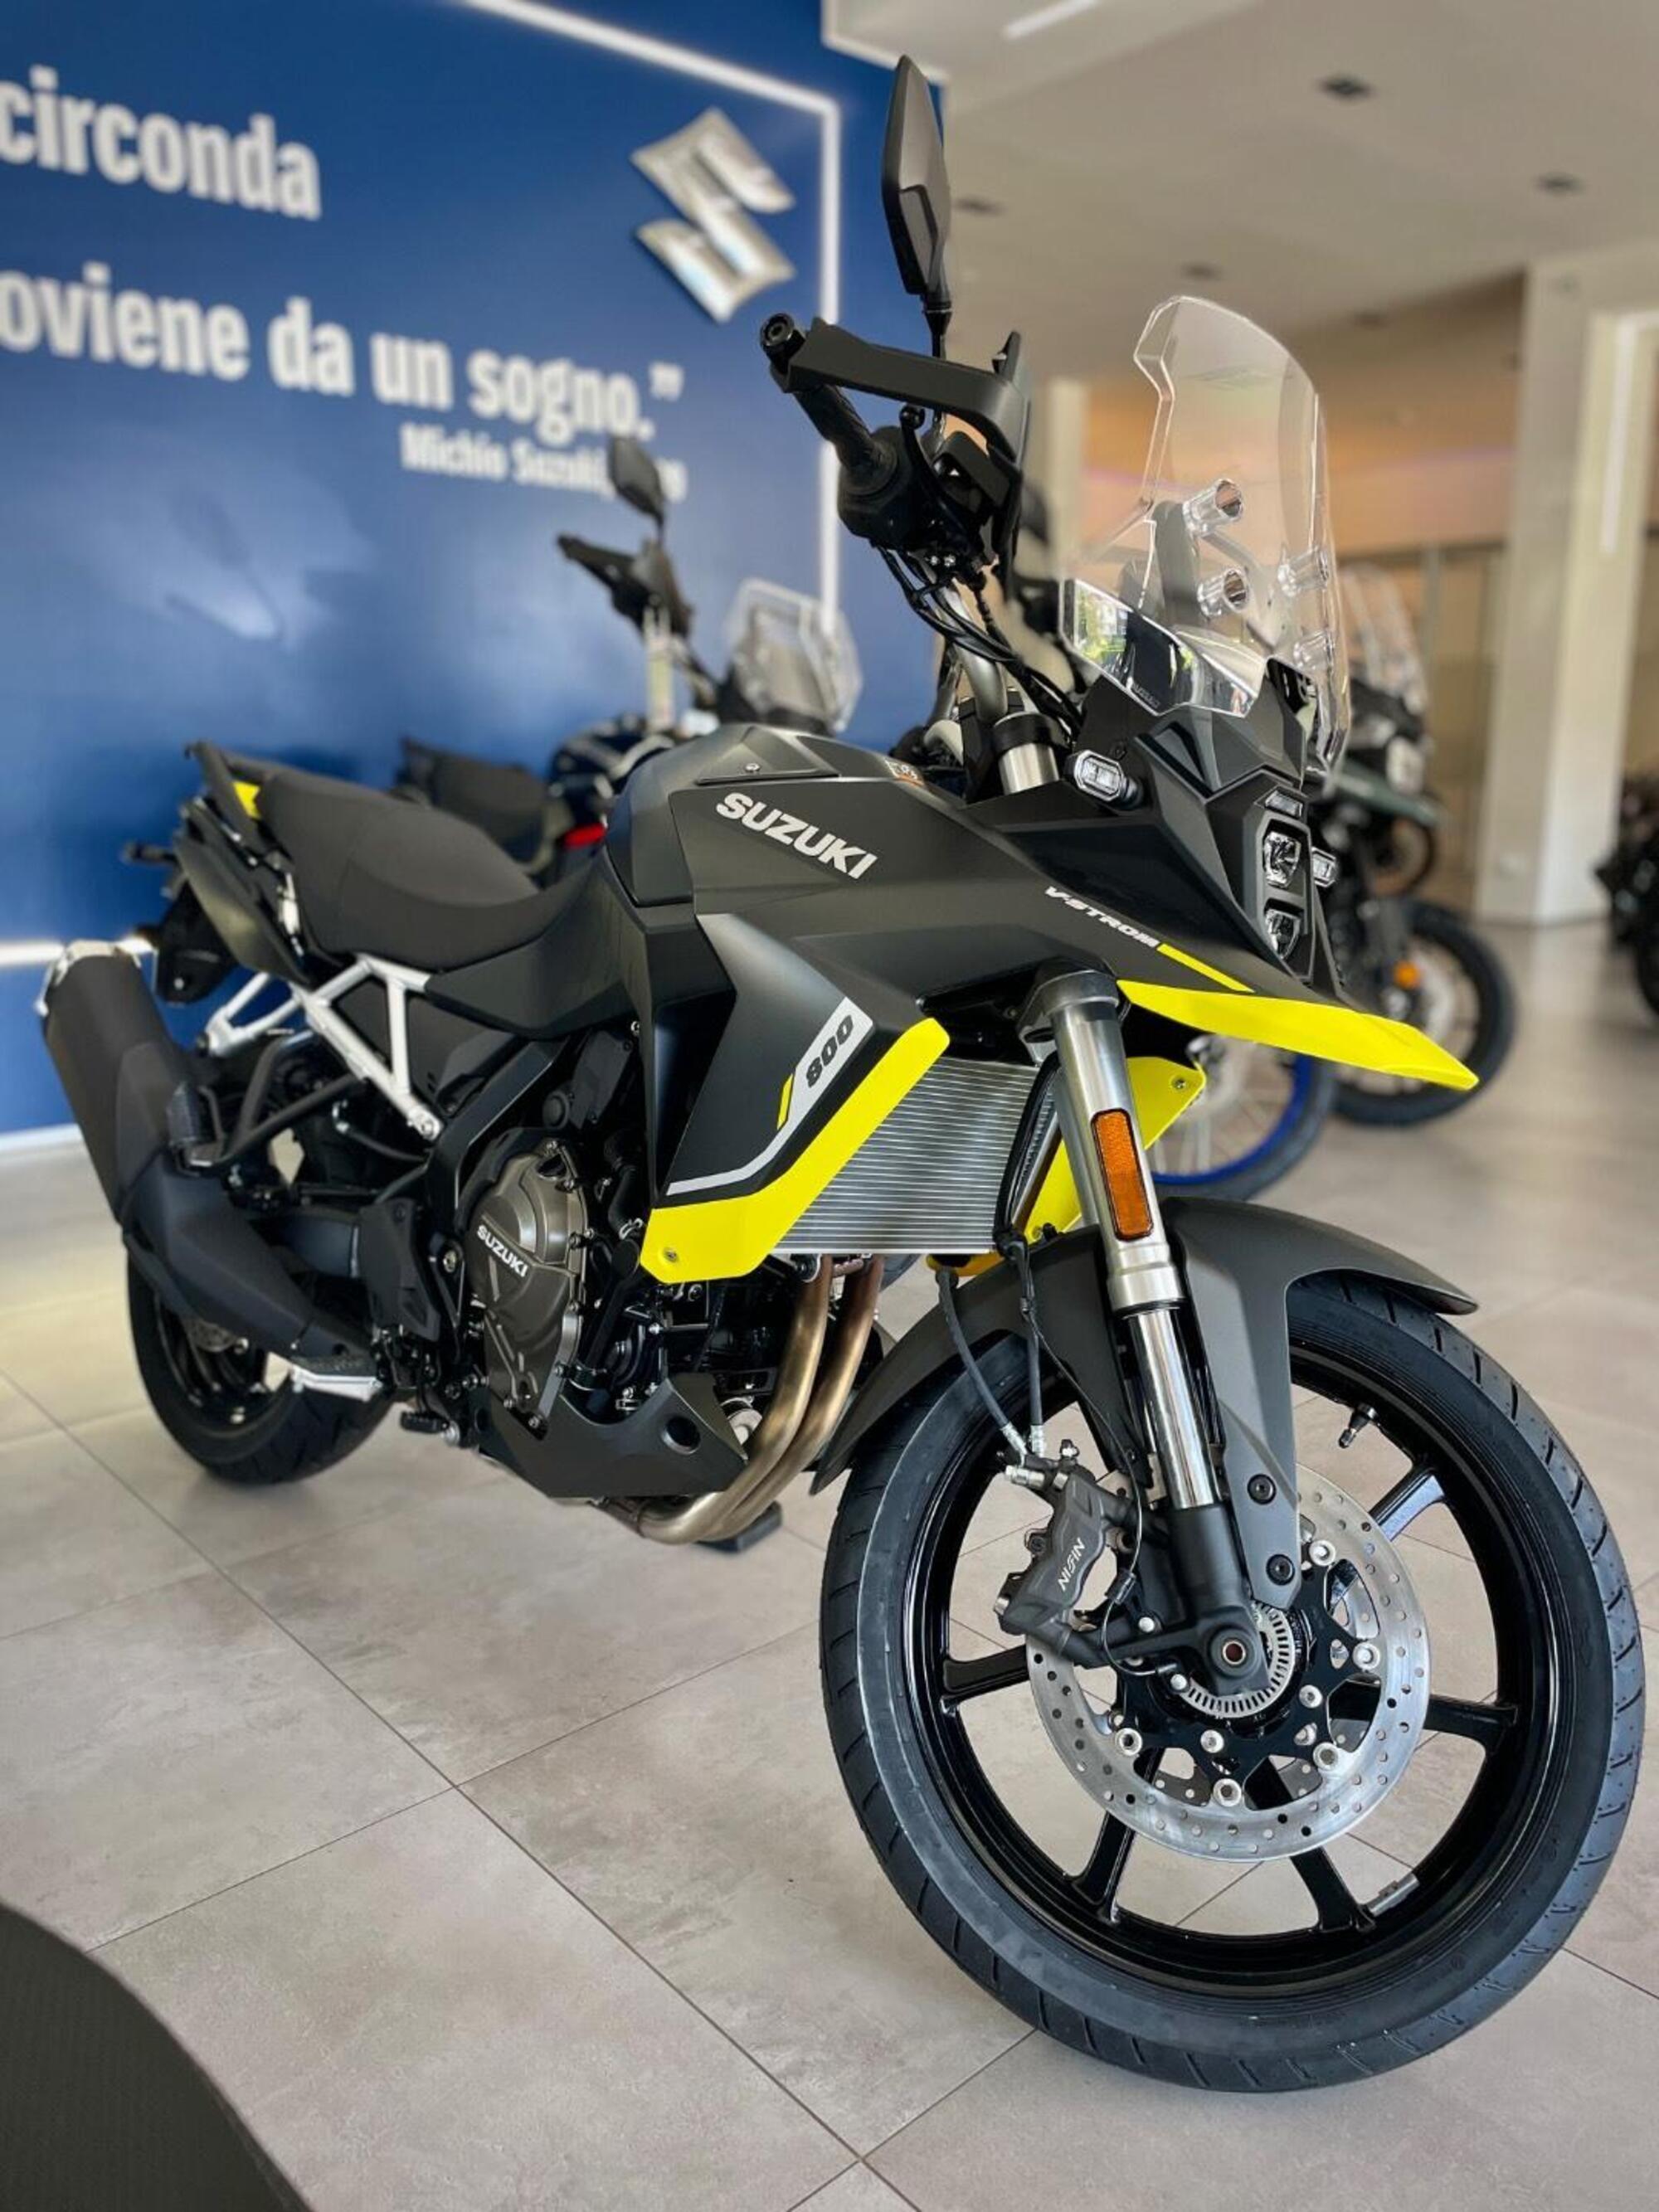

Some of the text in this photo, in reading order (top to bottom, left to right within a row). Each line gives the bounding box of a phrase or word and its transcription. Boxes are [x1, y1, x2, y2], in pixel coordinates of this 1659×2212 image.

[0, 64, 323, 220] circonda
[267, 295, 355, 396] da
[370, 333, 452, 411] un
[716, 792, 878, 880] SUZUKI
[805, 1014, 854, 1088] 800
[477, 1225, 528, 1277] SUZUKI
